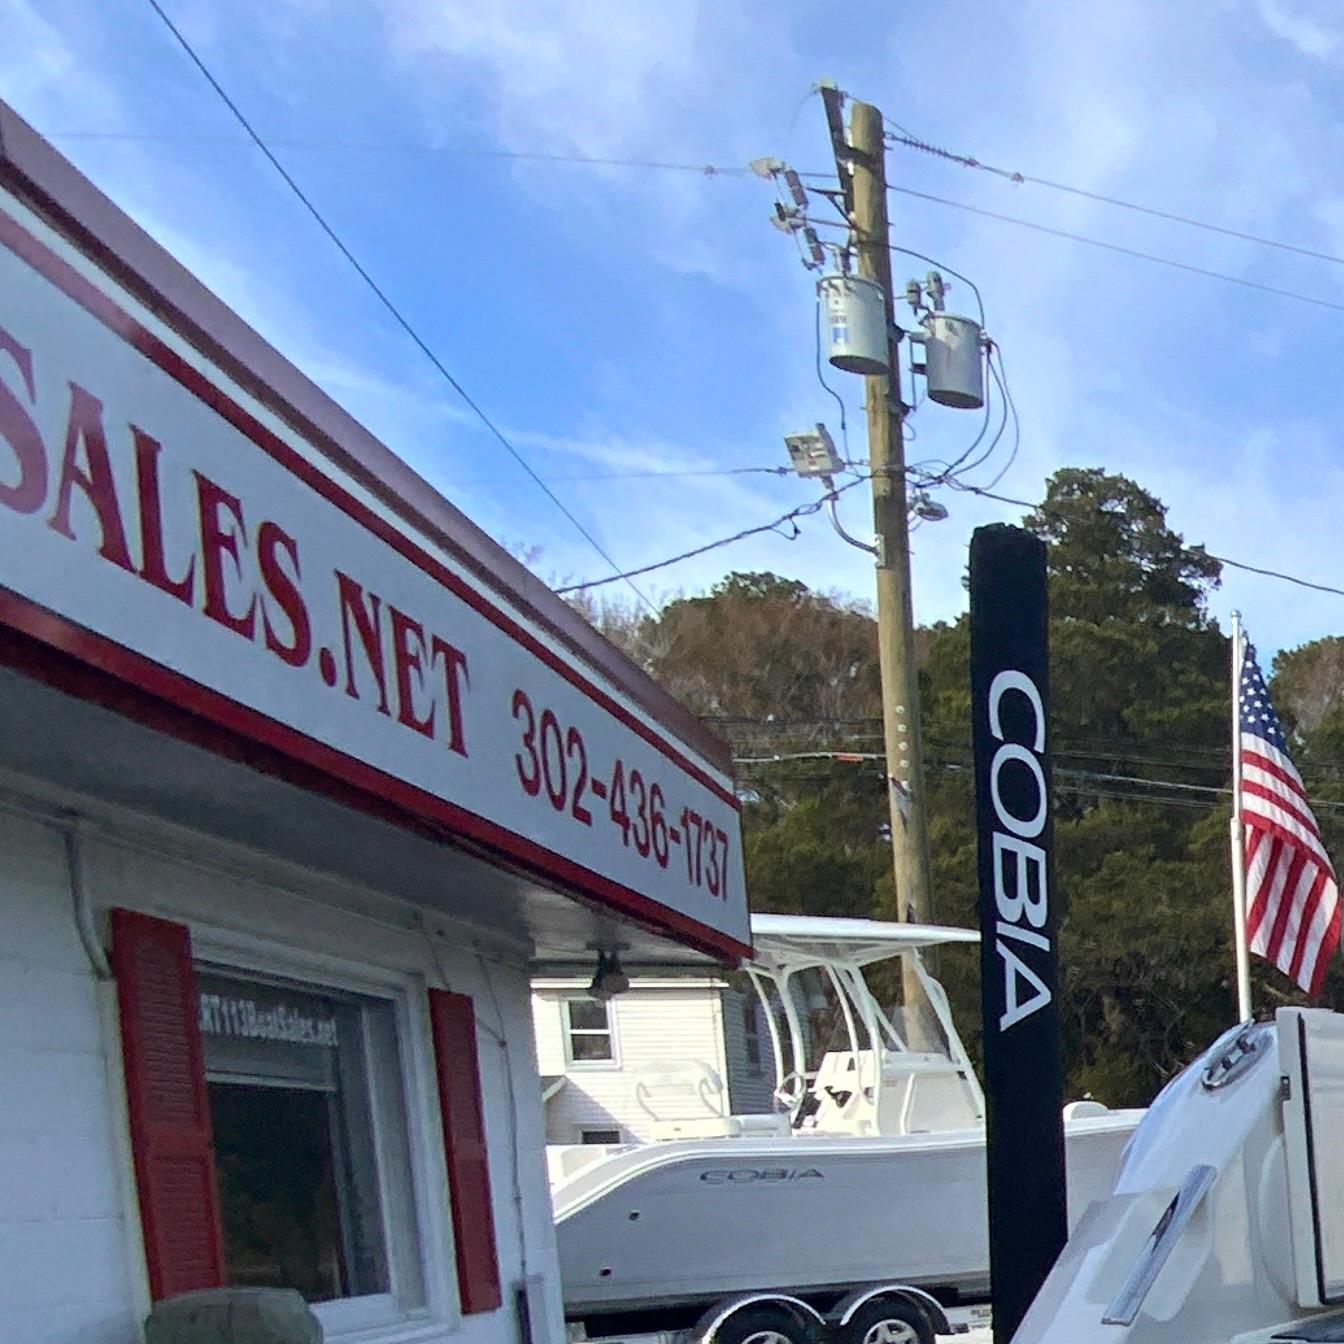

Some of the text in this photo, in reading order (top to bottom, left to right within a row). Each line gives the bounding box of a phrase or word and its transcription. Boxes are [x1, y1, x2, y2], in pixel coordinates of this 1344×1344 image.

[511, 690, 729, 902] 302-436-1737
[988, 670, 1052, 1032] COBIA
[700, 1168, 825, 1185] COBIA
